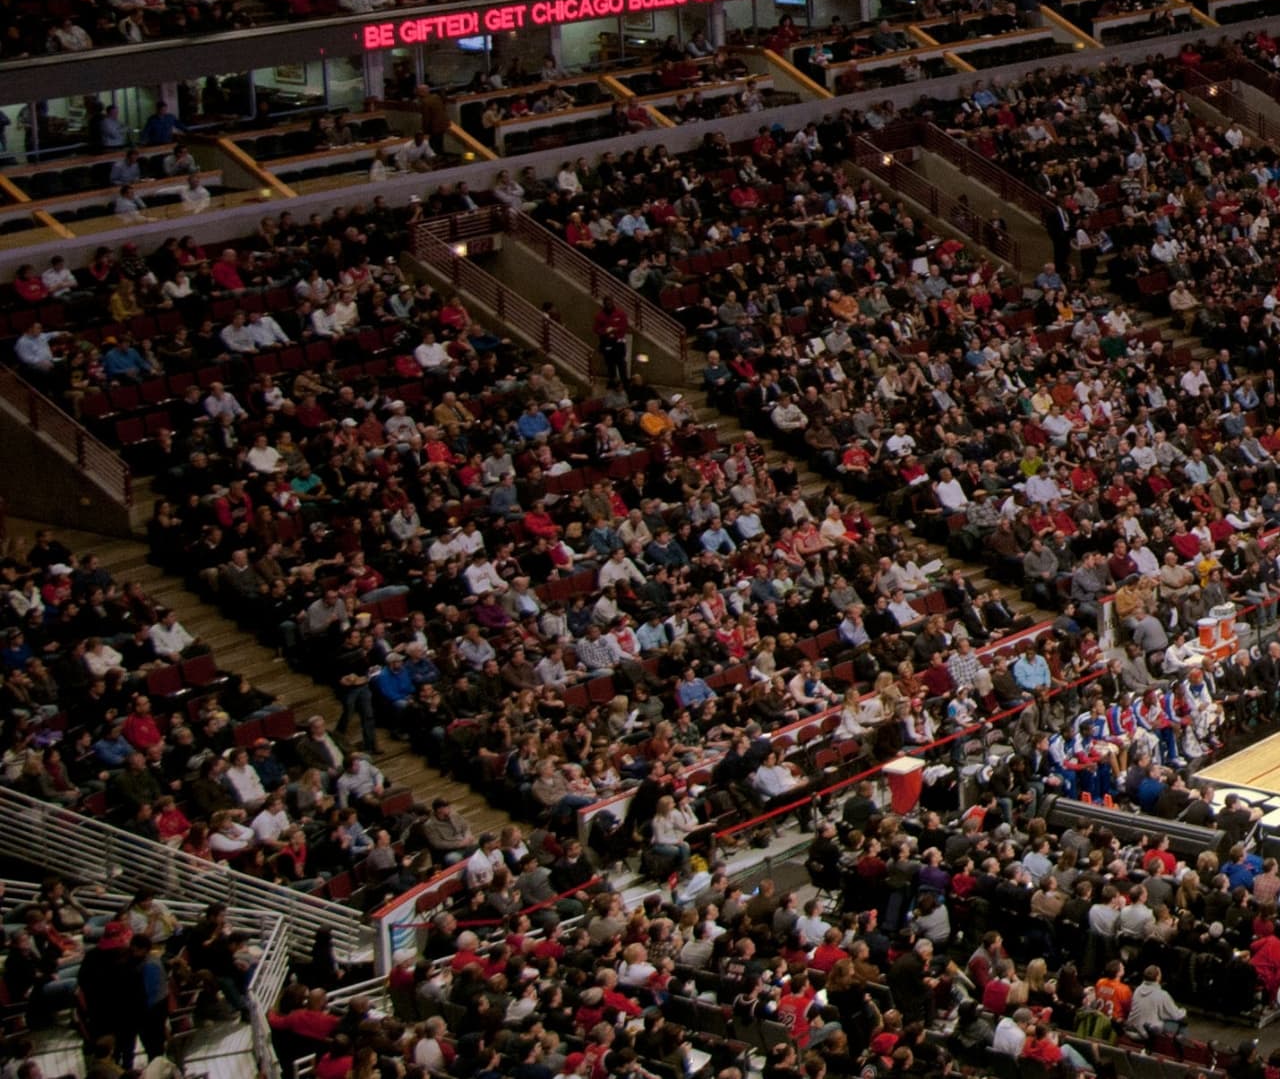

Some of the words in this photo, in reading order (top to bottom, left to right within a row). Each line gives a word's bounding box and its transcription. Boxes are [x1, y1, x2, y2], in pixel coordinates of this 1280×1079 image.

[363, 23, 395, 49] BE
[399, 12, 479, 45] GIFTED!
[484, 4, 527, 31] GET
